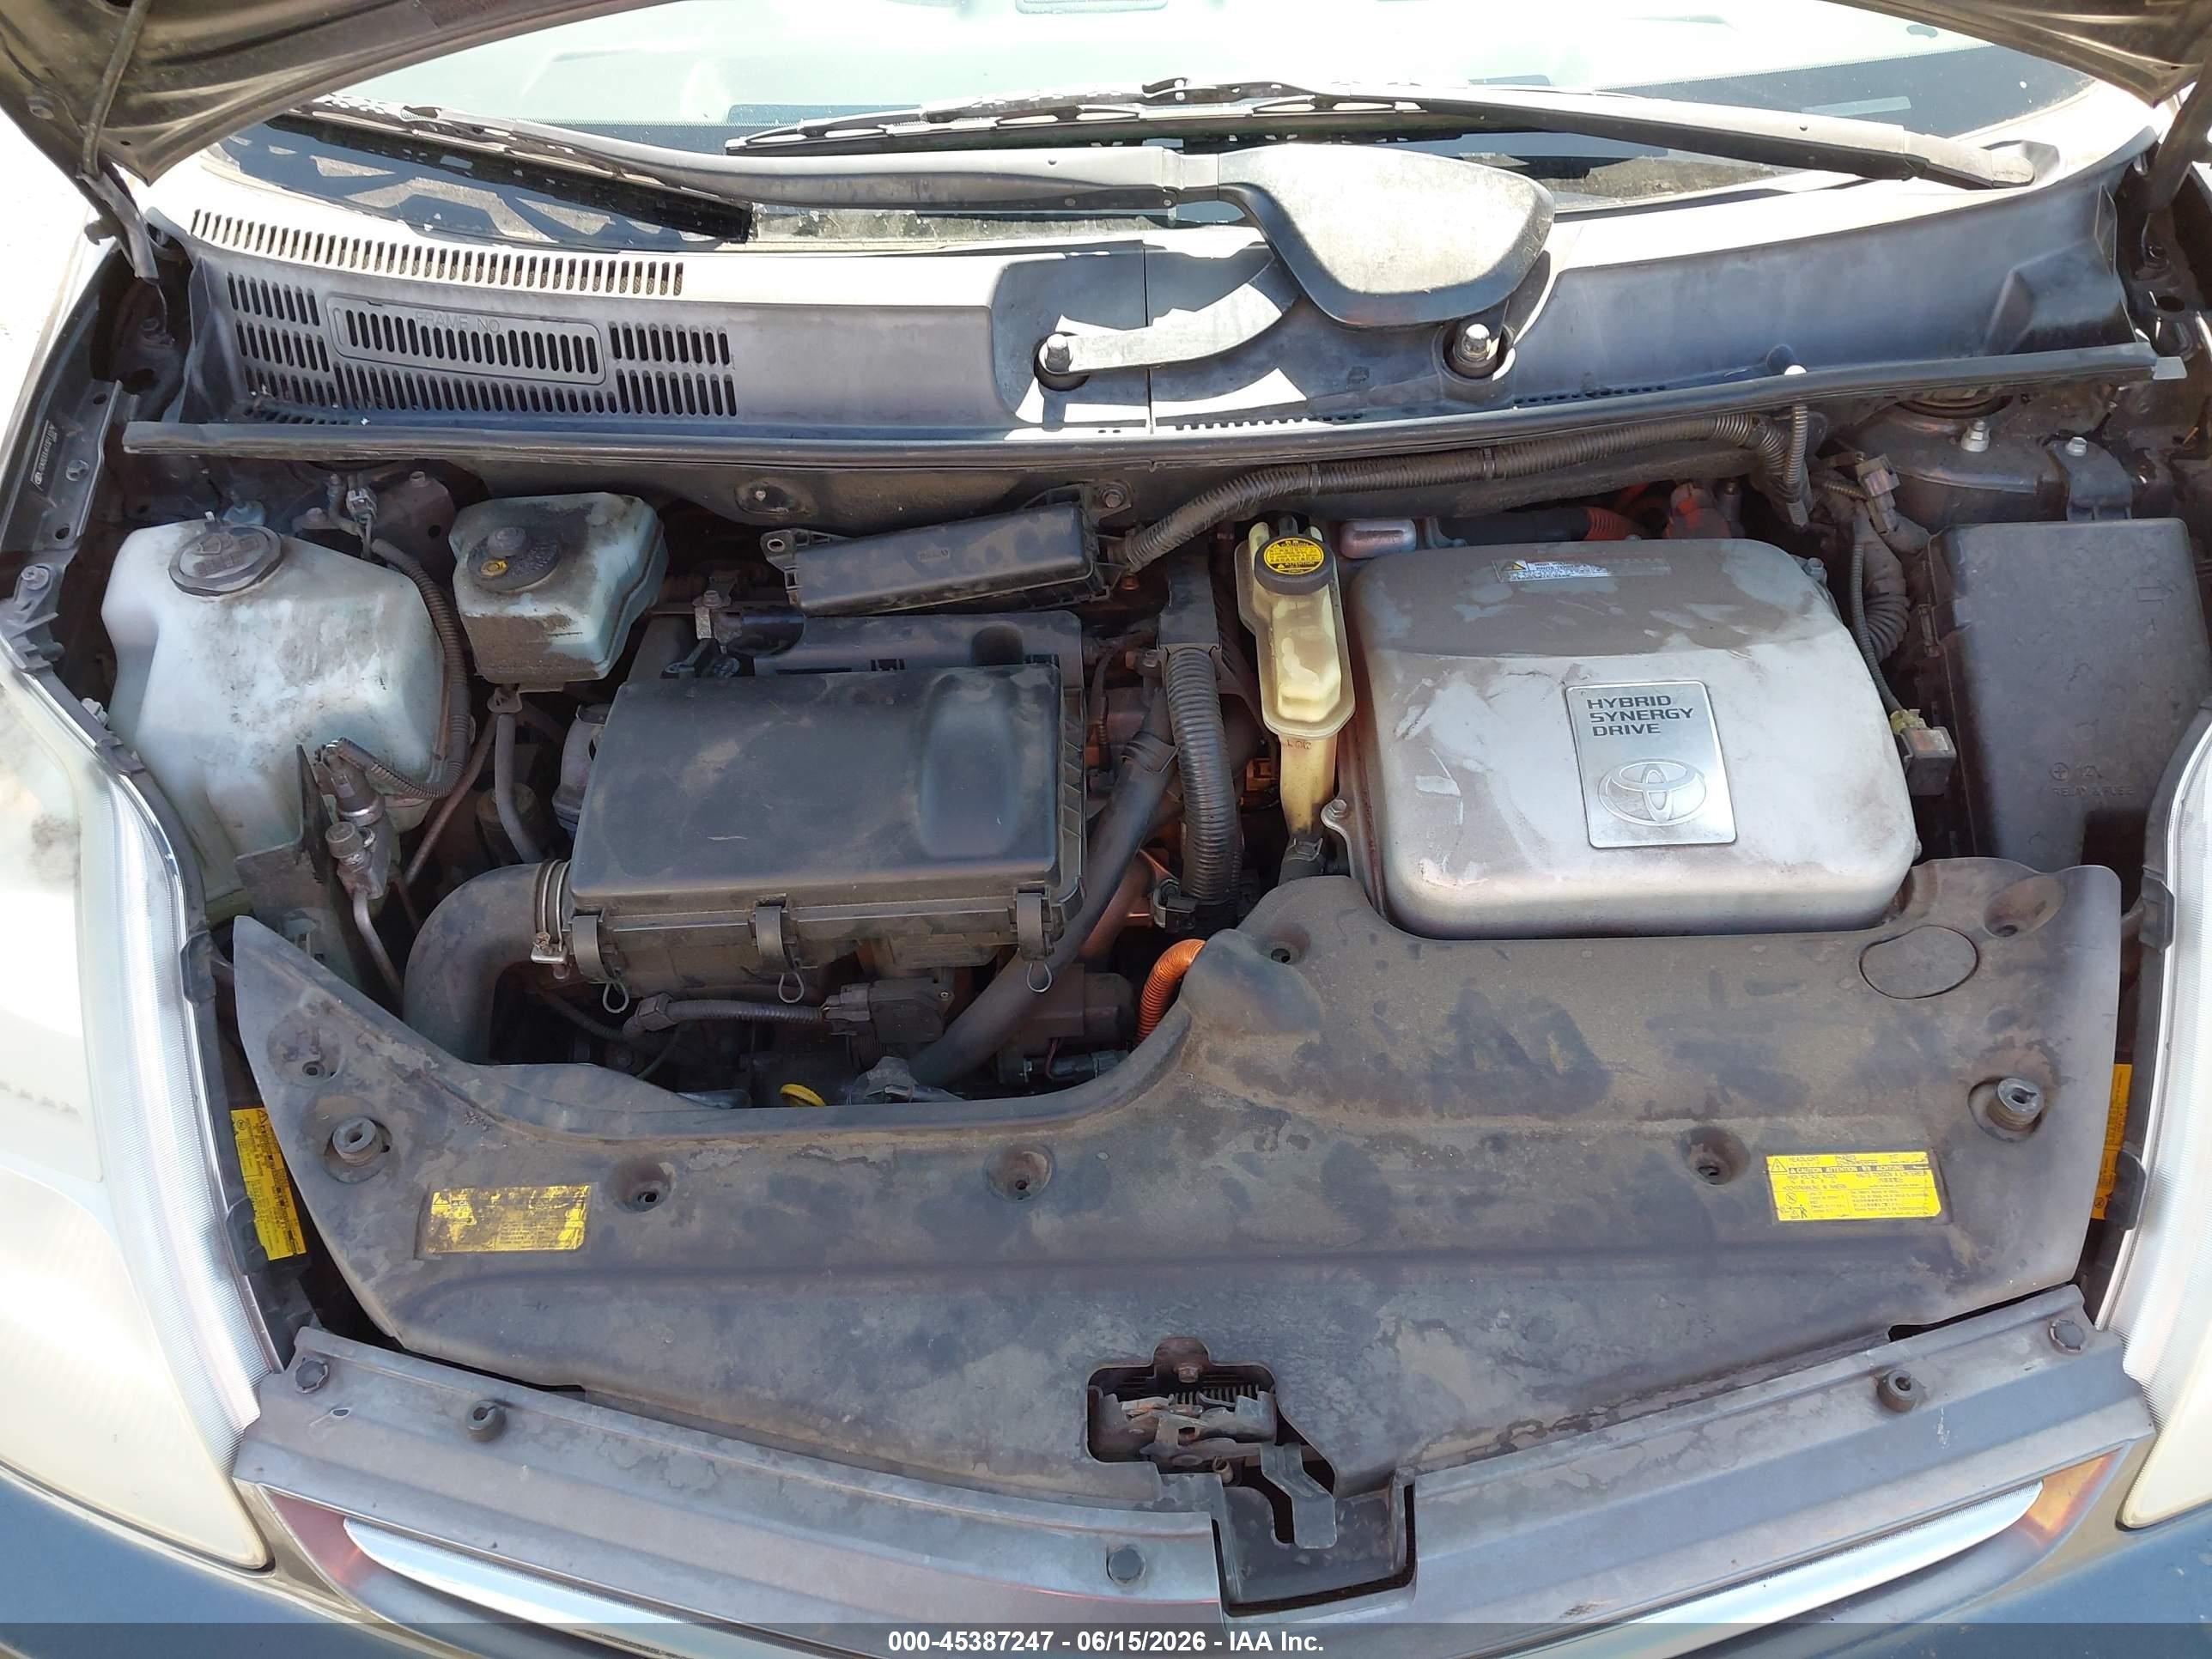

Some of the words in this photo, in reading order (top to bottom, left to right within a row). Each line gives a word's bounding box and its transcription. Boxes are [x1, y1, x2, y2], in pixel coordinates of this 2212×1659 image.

[416, 311, 468, 331] FRAME
[477, 317, 504, 334] NO.
[1587, 696, 1672, 708] HYBRID
[1589, 708, 1693, 723] SYNERGY
[1593, 723, 1661, 737] DRIVE
